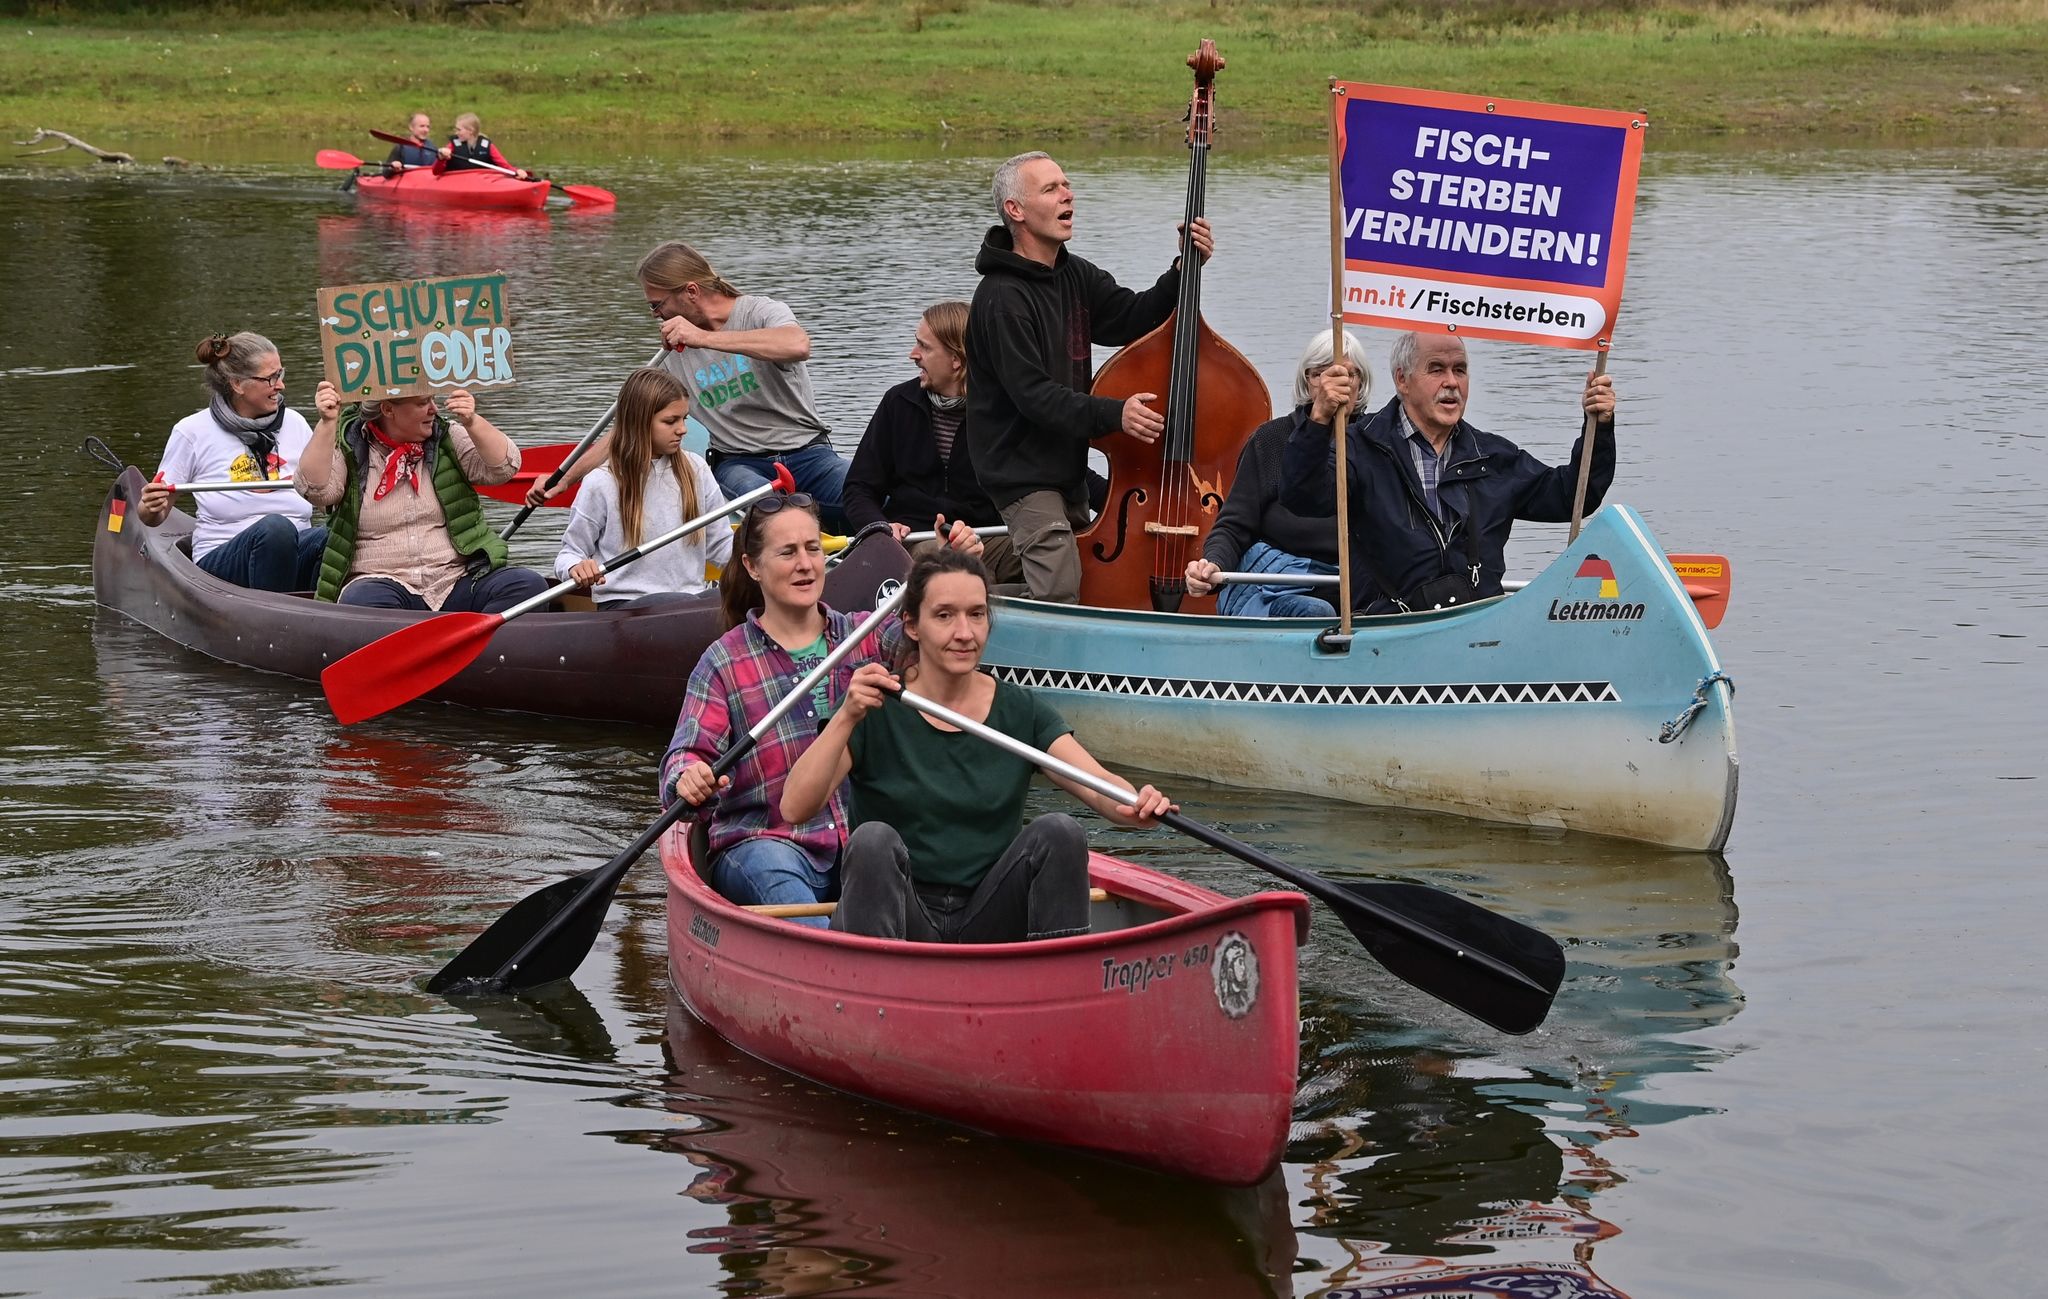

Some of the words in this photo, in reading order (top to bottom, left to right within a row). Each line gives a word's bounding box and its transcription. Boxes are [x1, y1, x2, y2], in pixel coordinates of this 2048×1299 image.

[1414, 126, 1550, 169] FISCH-
[1389, 169, 1561, 217] STERBEN
[1343, 207, 1601, 267] VERHINDERN!
[332, 275, 507, 335] SCHÜTZT
[1344, 285, 1406, 309] nn.it
[335, 338, 417, 392] DIE
[421, 327, 513, 380] ODER
[695, 354, 751, 389] SAVE
[699, 371, 760, 409] ODER
[1547, 599, 1647, 622] Lettmann
[1103, 955, 1176, 992] Trapper
[1183, 944, 1208, 968] 450
